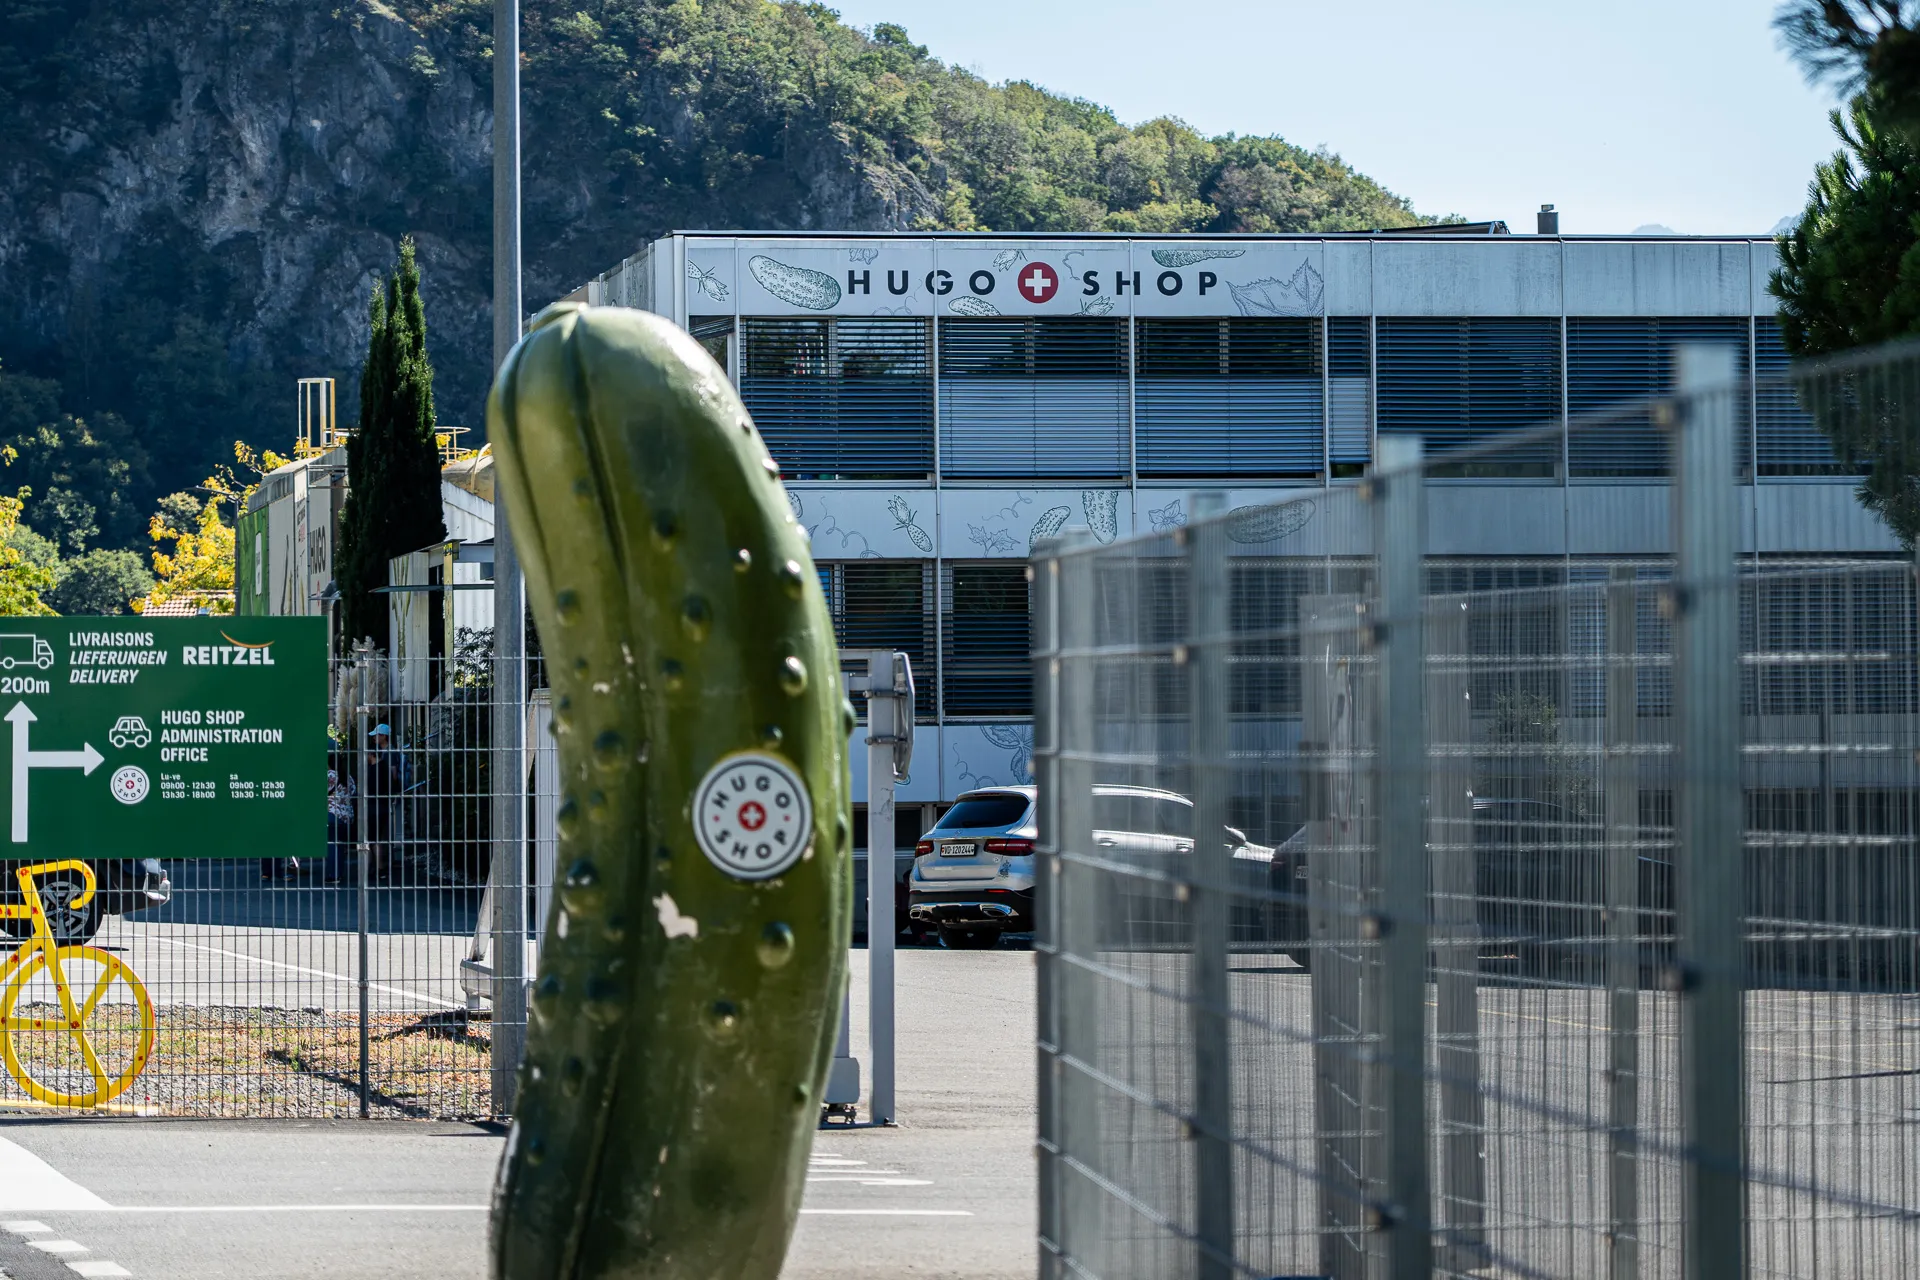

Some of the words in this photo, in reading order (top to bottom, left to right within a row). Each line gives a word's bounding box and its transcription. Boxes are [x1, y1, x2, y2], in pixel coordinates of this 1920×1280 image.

[847, 269, 996, 297] HUGO
[1082, 269, 1218, 297] SHOP
[309, 525, 327, 575] HUGO
[69, 632, 154, 647] LIVRAISONS
[69, 650, 168, 665] LIEFERUNGEN
[182, 645, 275, 665] REITZEL
[69, 669, 140, 684] DELIVERY
[0, 676, 50, 694] 200m
[161, 710, 202, 725] HUGO
[205, 710, 245, 725] SHOP
[160, 729, 283, 744] ADMINISTRATION
[160, 747, 209, 762] OFFICE
[117, 772, 143, 783] HUGO
[160, 772, 181, 781] Lu-ve
[118, 788, 141, 798] SHOP
[160, 781, 185, 790] 09h00
[191, 781, 216, 790] 12h30
[229, 781, 254, 790] 09h00
[261, 781, 285, 790] 12h30
[712, 775, 791, 809] HUGO
[161, 790, 185, 799] 13h30
[191, 790, 216, 799] 18h00
[231, 790, 254, 799] 13h30
[261, 790, 285, 799] 17h00
[715, 829, 788, 859] SHOP
